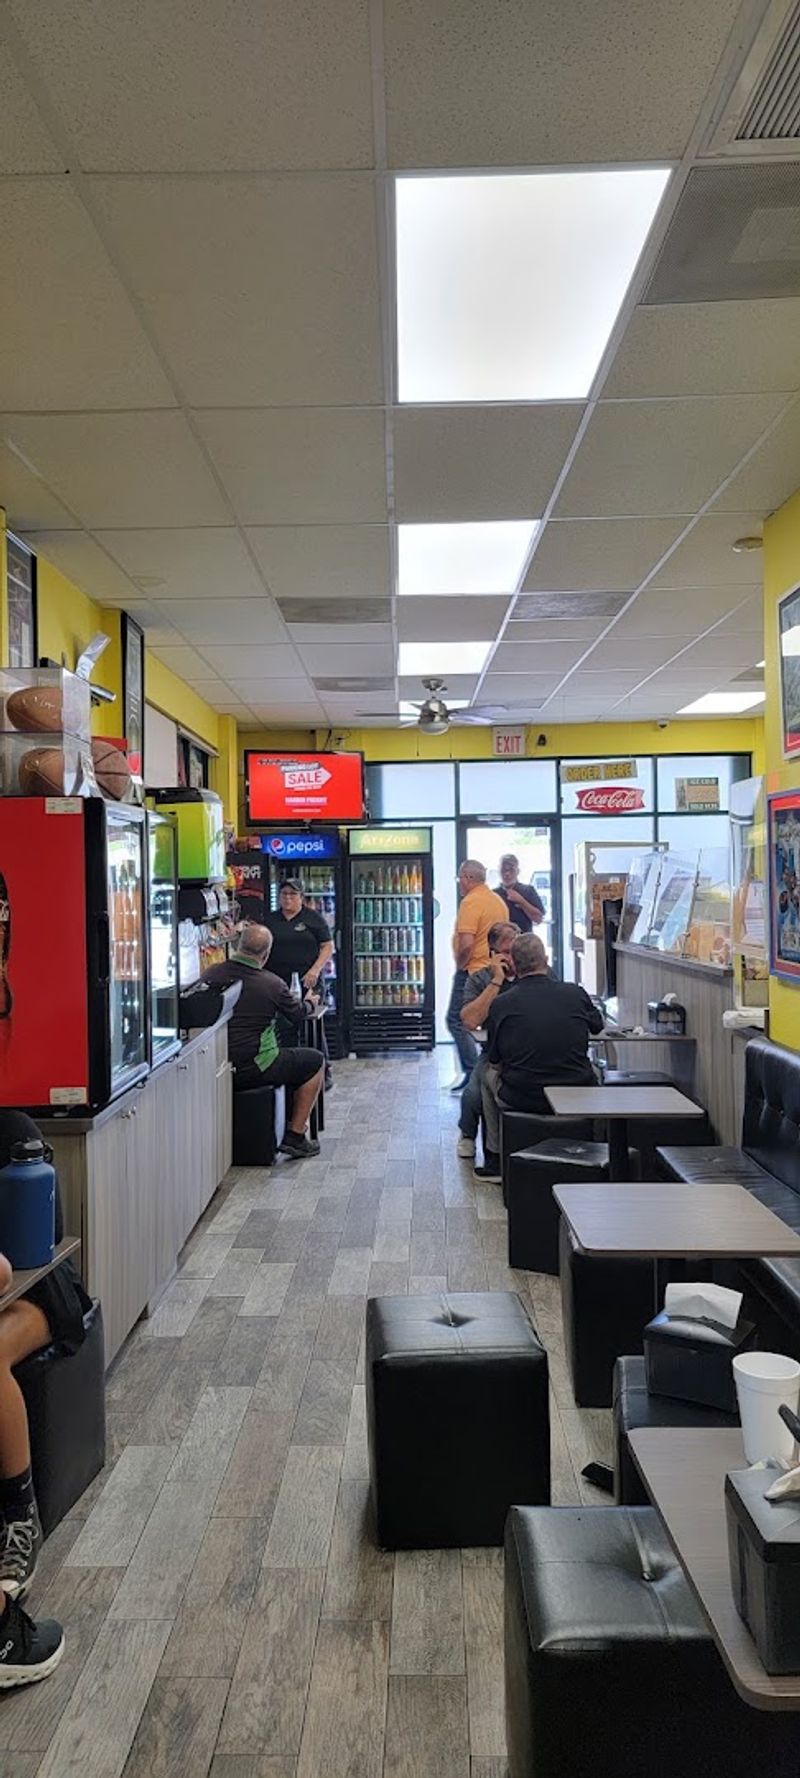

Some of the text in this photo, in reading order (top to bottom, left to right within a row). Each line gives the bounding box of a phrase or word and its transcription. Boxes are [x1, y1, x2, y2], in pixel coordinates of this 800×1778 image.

[496, 736, 521, 753] EXIT
[288, 771, 322, 785] SALE
[566, 763, 632, 782] ORDER HERE
[581, 790, 636, 809] Coca-Cola
[287, 839, 324, 854] pepsi
